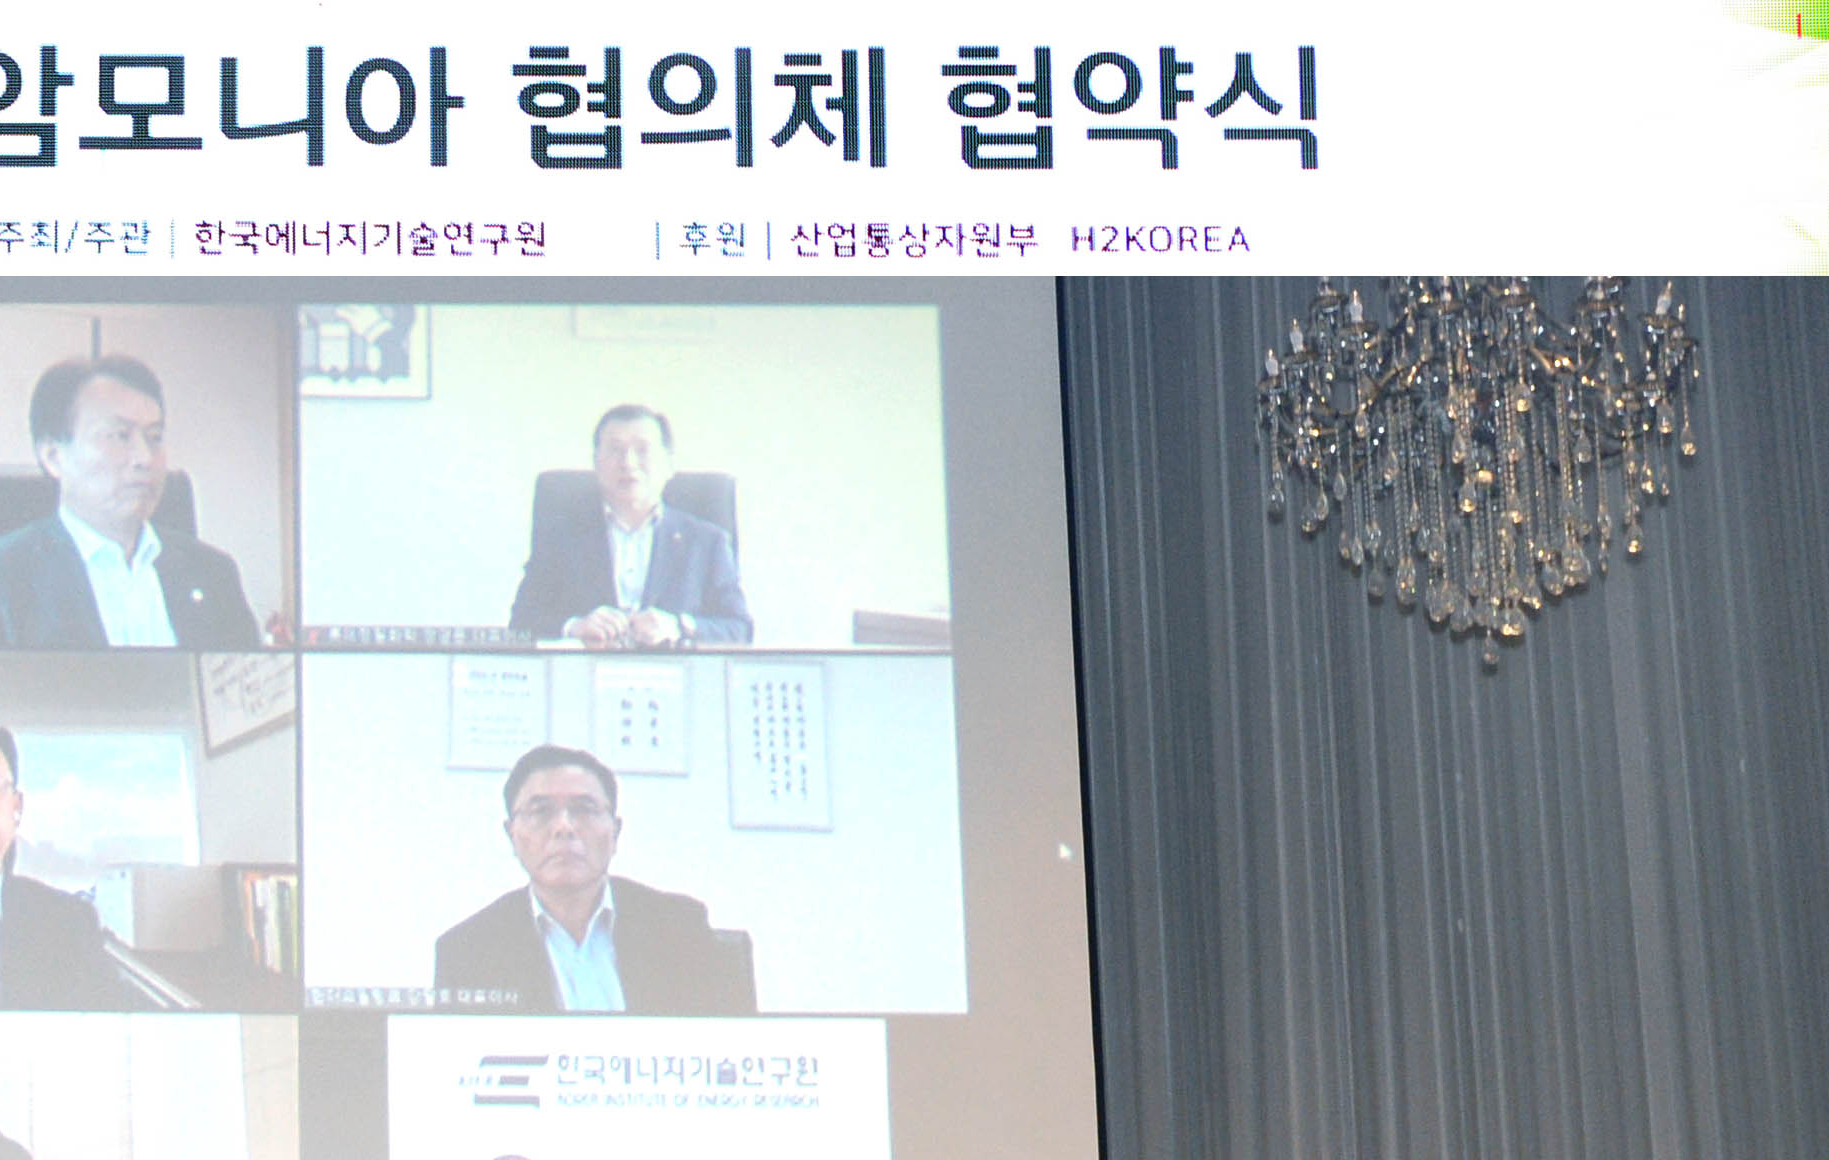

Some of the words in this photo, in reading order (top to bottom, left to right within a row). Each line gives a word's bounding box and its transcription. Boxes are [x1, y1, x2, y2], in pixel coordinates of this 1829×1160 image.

[513, 46, 889, 171] 협의체
[942, 46, 1321, 171] 협약식
[195, 220, 548, 258] 한국에너지기술연구원
[679, 221, 747, 258] 후원
[791, 222, 1041, 260] 산업통상자원부
[1072, 225, 1253, 254] H2KOREA
